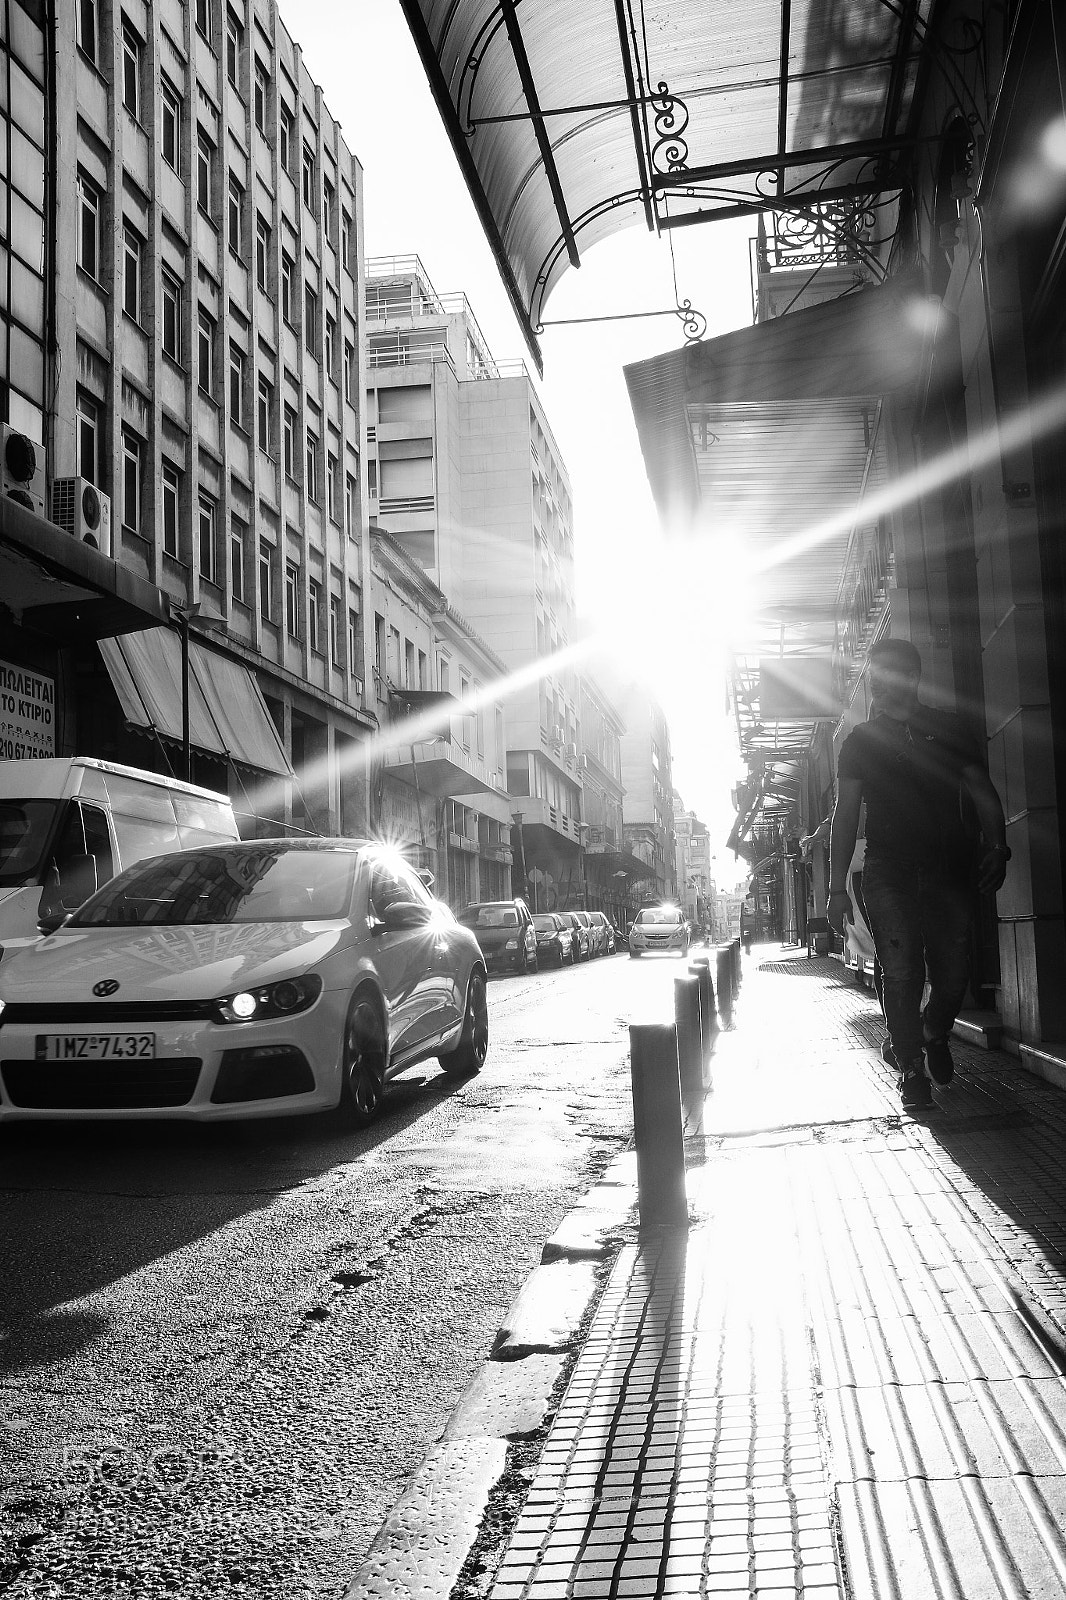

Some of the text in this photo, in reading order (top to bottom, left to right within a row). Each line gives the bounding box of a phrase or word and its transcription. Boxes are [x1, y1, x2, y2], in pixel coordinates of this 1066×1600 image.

[2, 693, 51, 724] ΤΟ ΚΤΙΡΙΟ
[8, 724, 52, 741] PRAXIS
